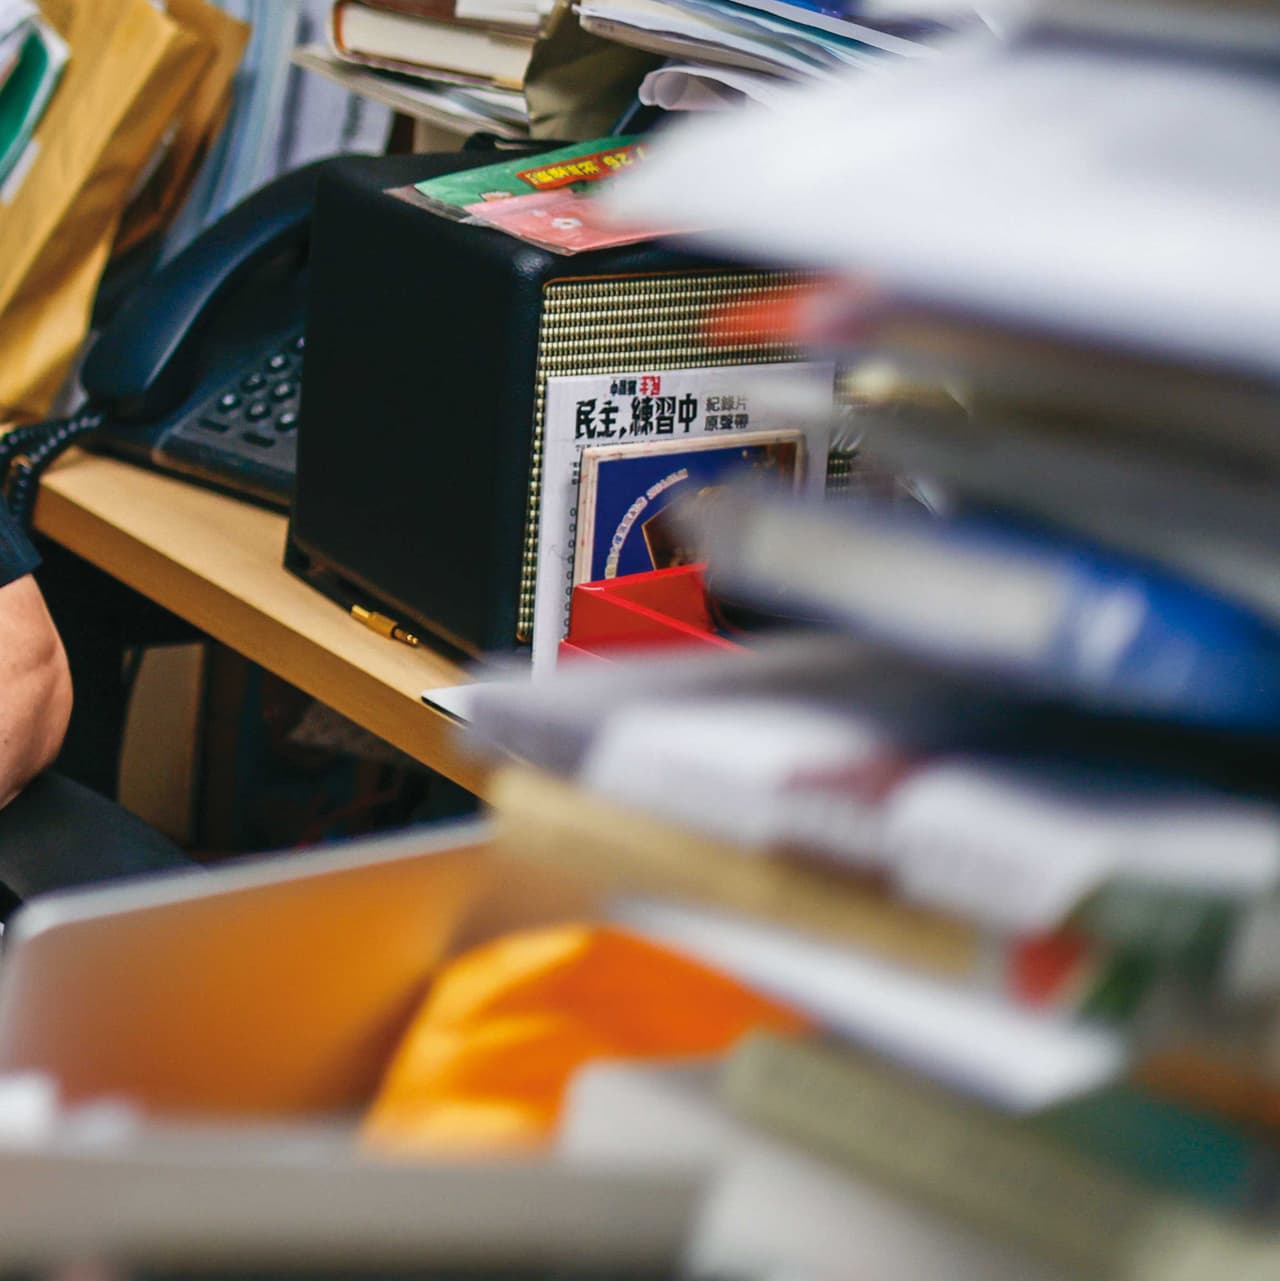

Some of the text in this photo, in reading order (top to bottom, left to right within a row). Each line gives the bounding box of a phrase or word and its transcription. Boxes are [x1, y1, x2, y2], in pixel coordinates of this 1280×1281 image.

[705, 397, 748, 413] 紀錄片
[704, 414, 749, 432] 原聲帶
